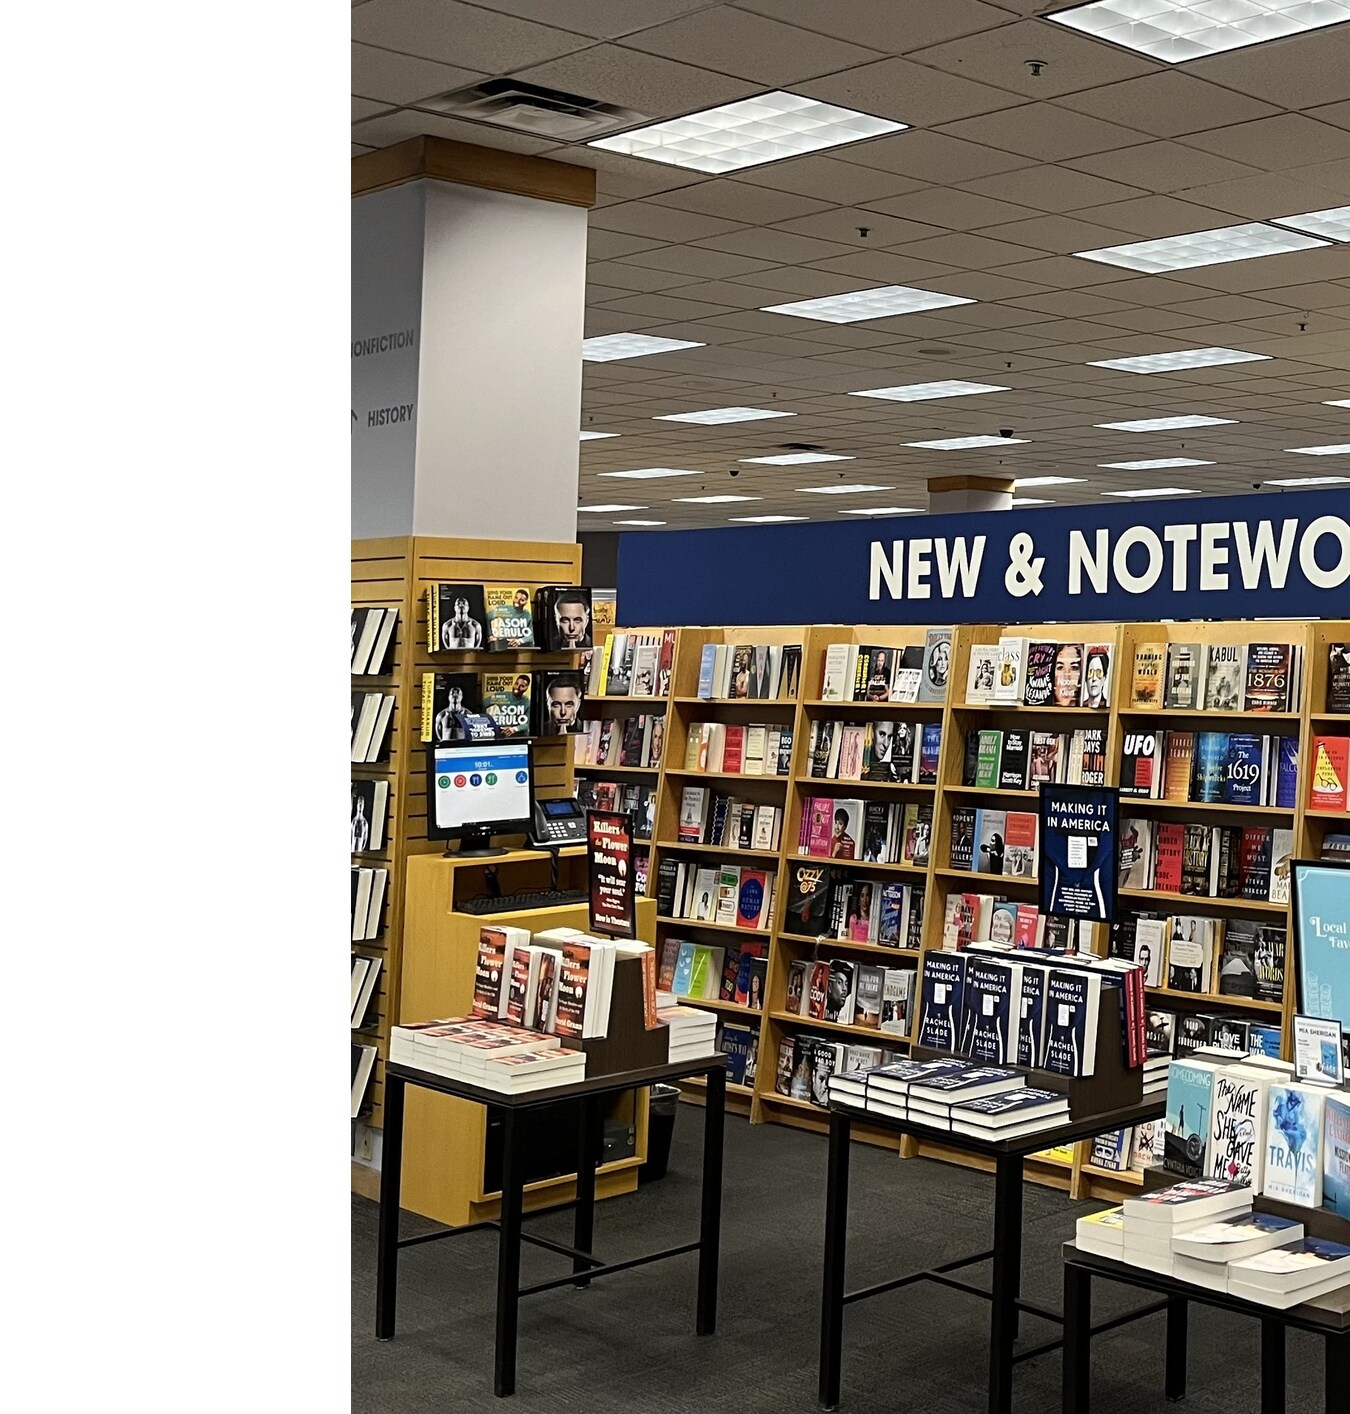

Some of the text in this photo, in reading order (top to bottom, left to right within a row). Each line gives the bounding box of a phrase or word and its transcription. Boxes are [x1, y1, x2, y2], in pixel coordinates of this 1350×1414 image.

[368, 404, 414, 428] HISTORY
[869, 535, 986, 600] NEW
[1005, 531, 1046, 598] &
[998, 647, 1020, 662] class
[1210, 647, 1238, 662] KABUL
[1248, 673, 1285, 688] 1876
[1124, 735, 1155, 756] UFO
[1238, 751, 1249, 759] The
[1227, 760, 1260, 785] 1619
[1051, 801, 1107, 816] MAKING IT
[593, 821, 620, 835] Killers
[1047, 816, 1110, 832] IN AMERICA
[602, 838, 628, 852] Flower
[1245, 834, 1270, 842] DIFFER
[594, 852, 617, 866] Moon
[1310, 916, 1346, 937] Local
[927, 961, 950, 970] MAKING
[932, 972, 960, 982] AMERICA
[975, 971, 999, 982] MAKING
[982, 982, 1007, 994] AMERICA
[1051, 980, 1082, 992] MAKING IT
[1055, 992, 1083, 1003] AMERICA
[925, 1016, 951, 1028] RACHEL
[926, 1027, 948, 1036] SLADE
[975, 1028, 999, 1040] RACHEL
[1220, 1032, 1240, 1045] LOVE
[1299, 1027, 1336, 1038] MIA SHERIDAN
[976, 1039, 996, 1050] SLADE
[1050, 1040, 1074, 1052] RACHEL
[1250, 1034, 1263, 1048] THE
[1051, 1051, 1071, 1061] SLADE
[1227, 1084, 1258, 1118] NAME
[1269, 1145, 1315, 1173] TRAVIS
[1268, 1184, 1310, 1199] MIA SHERIDAN
